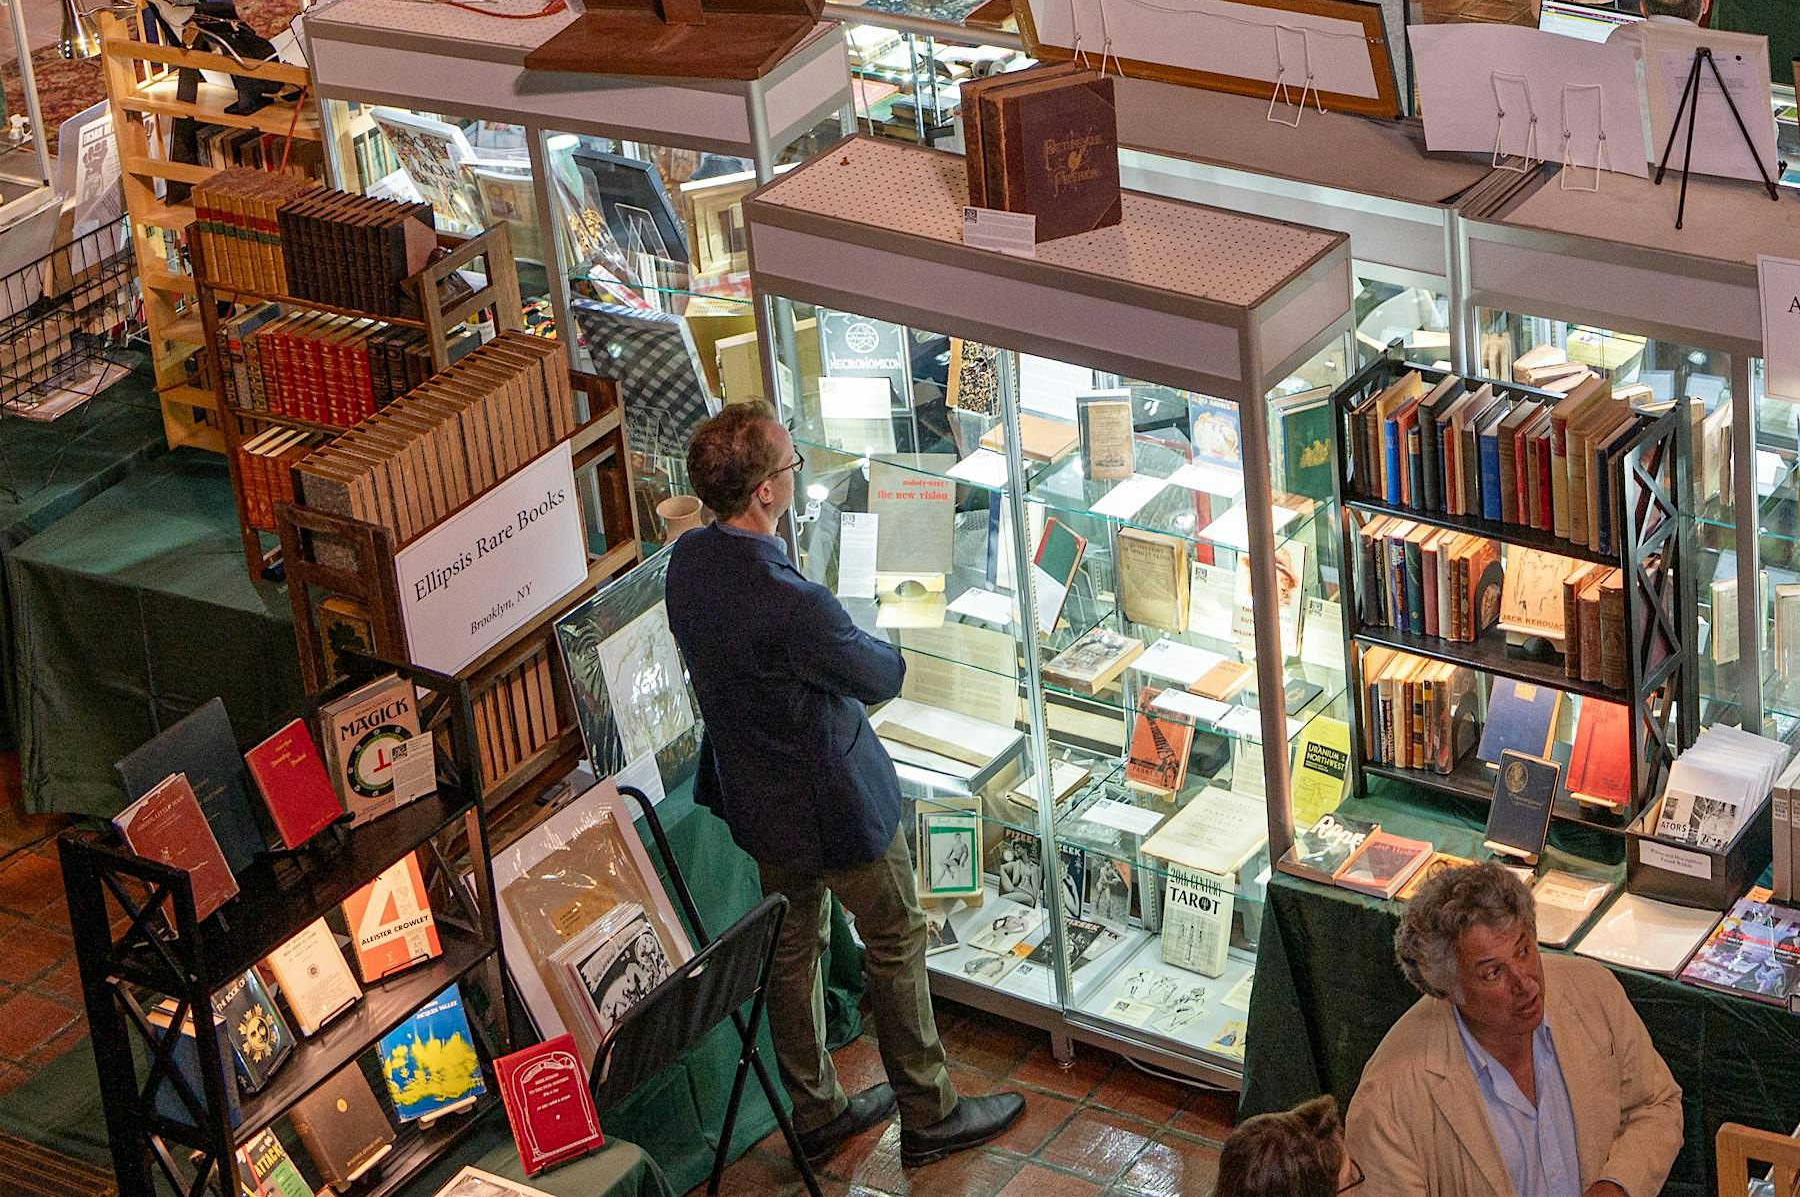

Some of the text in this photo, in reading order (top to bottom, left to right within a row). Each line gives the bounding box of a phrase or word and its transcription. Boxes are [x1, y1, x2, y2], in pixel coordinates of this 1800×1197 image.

[829, 352, 903, 371] NECRONOMICON
[877, 488, 949, 501] the new vision
[413, 488, 566, 603] Ellipsis Rare Books
[470, 582, 535, 636] Brooklyn, NY
[1501, 613, 1564, 632] JACK KEROUAC
[340, 697, 410, 742] MAGICK
[1306, 751, 1346, 772] NORTHWEST
[1308, 743, 1340, 761] URANIUM
[1169, 885, 1221, 916] TAROT
[361, 914, 430, 947] ALEISTER CROWLEY
[215, 997, 228, 1013] THE
[225, 983, 240, 1002] BOOK
[254, 1143, 283, 1178] ATTACK
